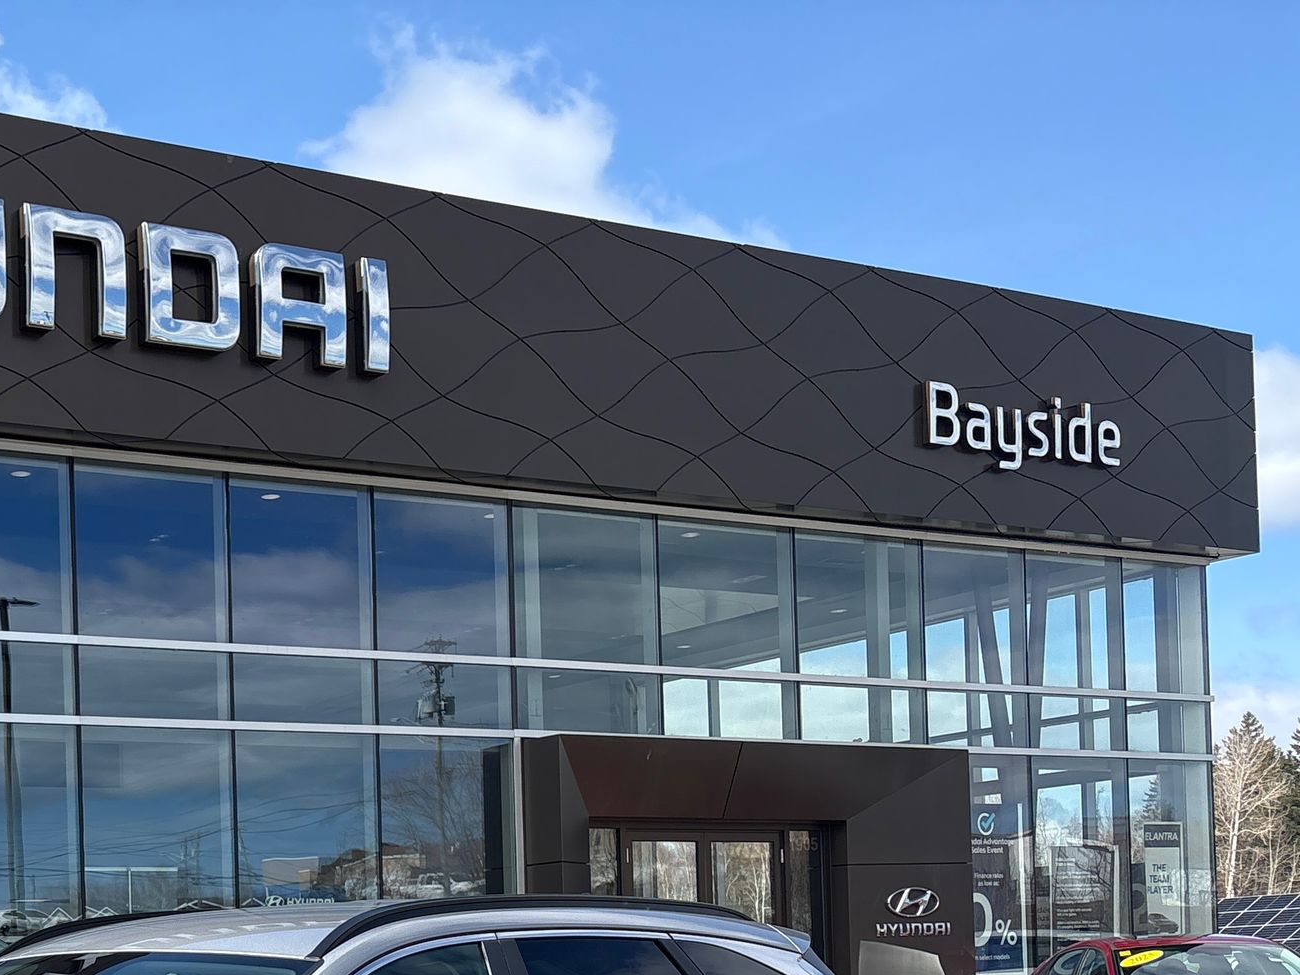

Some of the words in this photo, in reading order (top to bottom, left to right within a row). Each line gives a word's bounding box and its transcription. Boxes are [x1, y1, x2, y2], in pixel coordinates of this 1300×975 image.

[925, 380, 1121, 471] Bayside
[1145, 831, 1179, 841] ELANTRA
[983, 838, 1014, 847] Advantage
[987, 846, 1004, 854] Event
[1152, 863, 1167, 873] THE
[1149, 874, 1170, 884] TEAM
[1147, 885, 1174, 895] PLAYER
[875, 922, 951, 937] HYUNDAI
